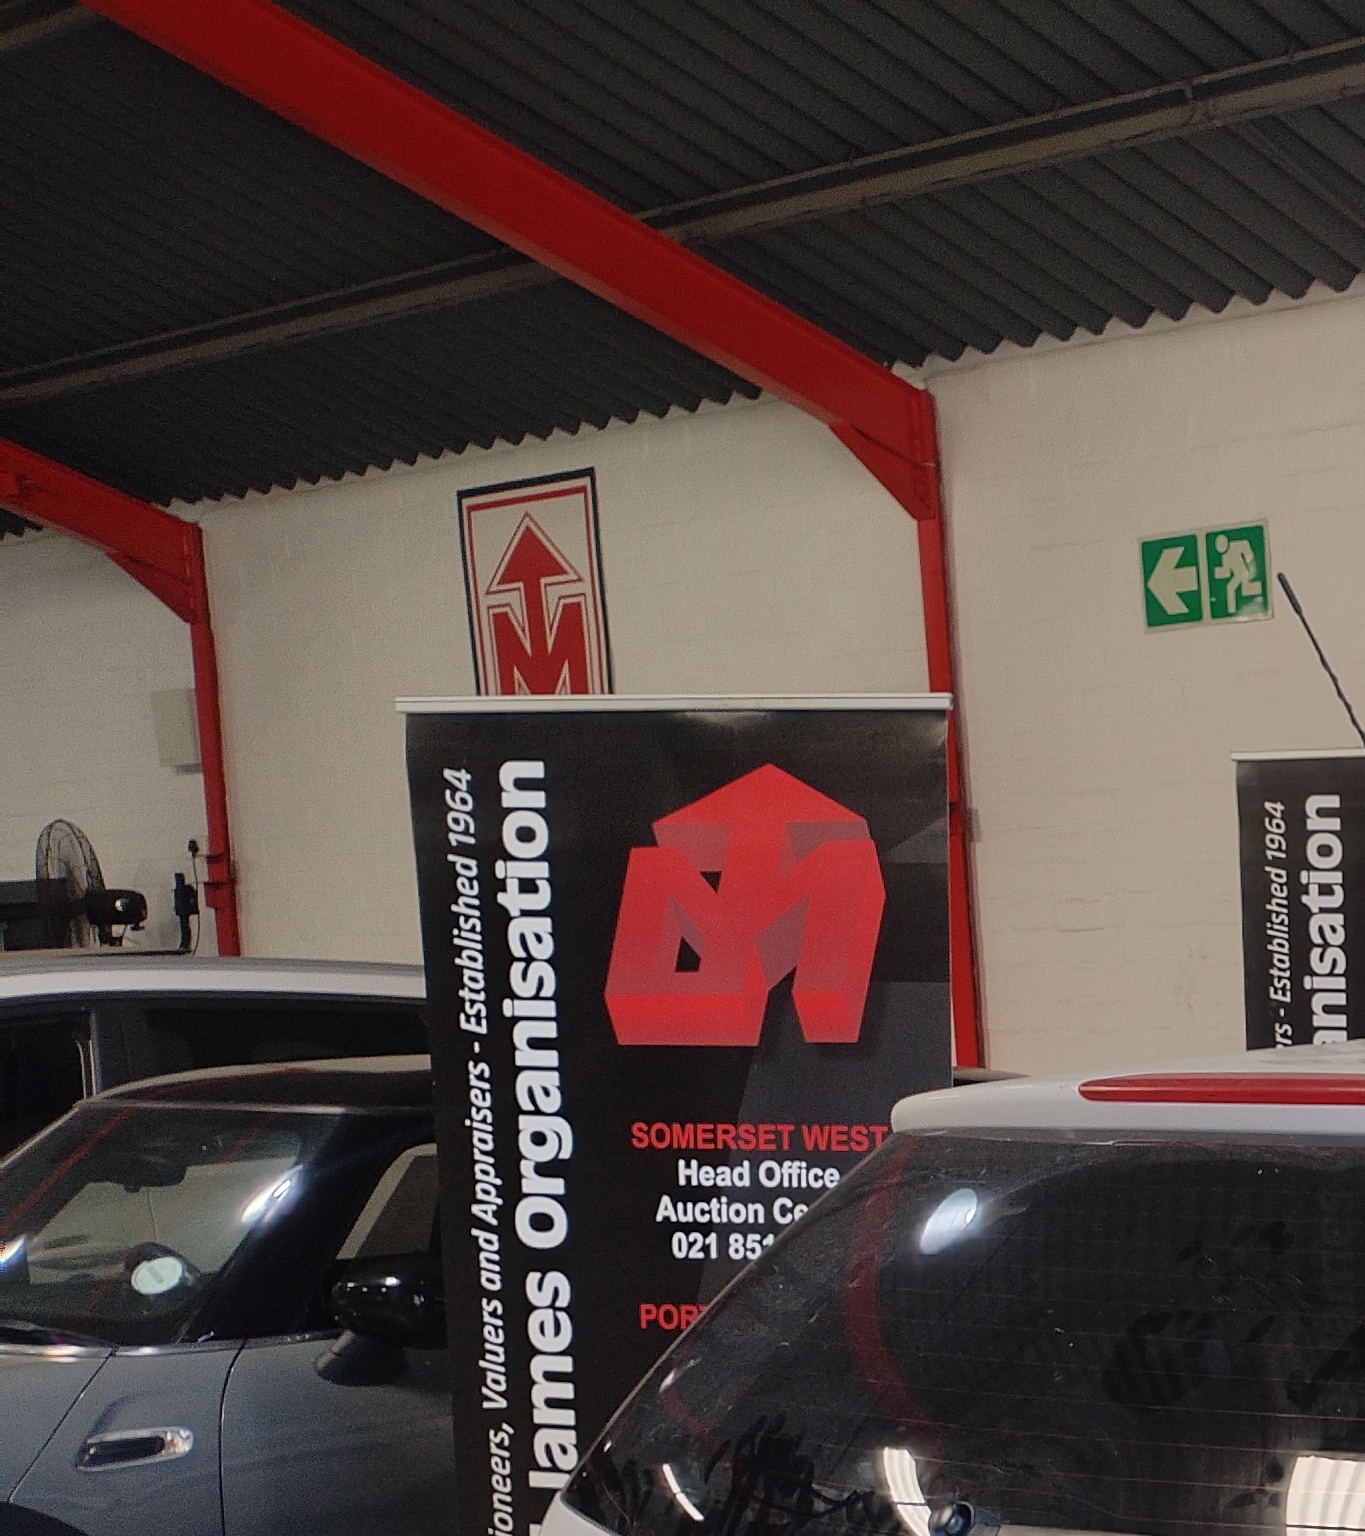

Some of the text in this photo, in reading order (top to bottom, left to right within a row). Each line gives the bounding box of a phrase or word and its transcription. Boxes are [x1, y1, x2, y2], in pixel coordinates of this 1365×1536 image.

[443, 767, 476, 846] 1964
[1264, 800, 1288, 861] 1964
[447, 853, 488, 1035] Established
[1264, 865, 1292, 1004] Established
[464, 1059, 504, 1226] Appraisers
[631, 1121, 889, 1152] SOMERSET WEST
[677, 1158, 841, 1188] Head Office
[655, 1194, 766, 1224] Auction
[470, 1227, 503, 1292] and
[671, 1231, 718, 1260] 021
[639, 1303, 705, 1330] POR
[478, 1296, 509, 1410] Valuers
